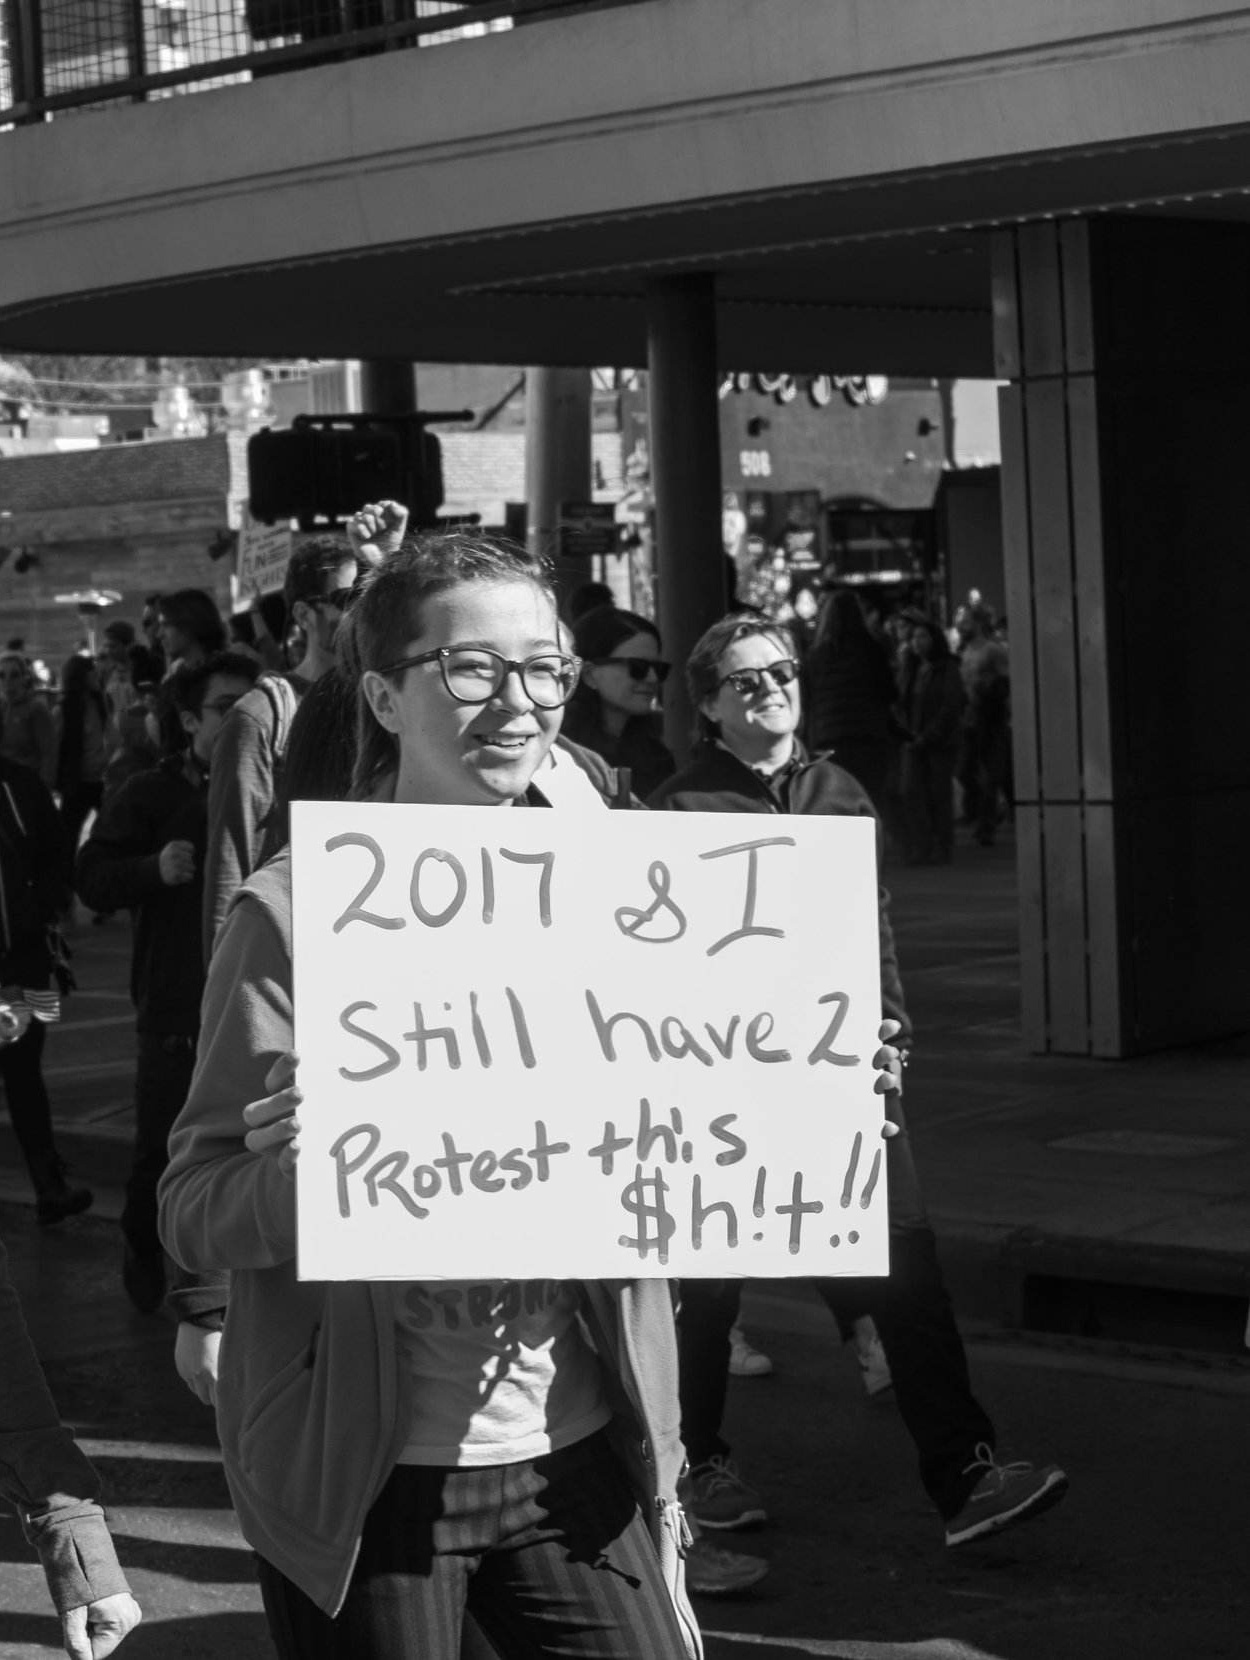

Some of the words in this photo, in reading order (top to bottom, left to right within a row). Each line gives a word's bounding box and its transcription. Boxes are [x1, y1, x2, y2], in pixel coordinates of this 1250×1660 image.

[325, 832, 556, 934] 2017
[613, 860, 688, 945] &
[697, 836, 797, 957] I
[337, 986, 537, 1083] Still
[584, 989, 792, 1068] have
[806, 991, 862, 1068] 2
